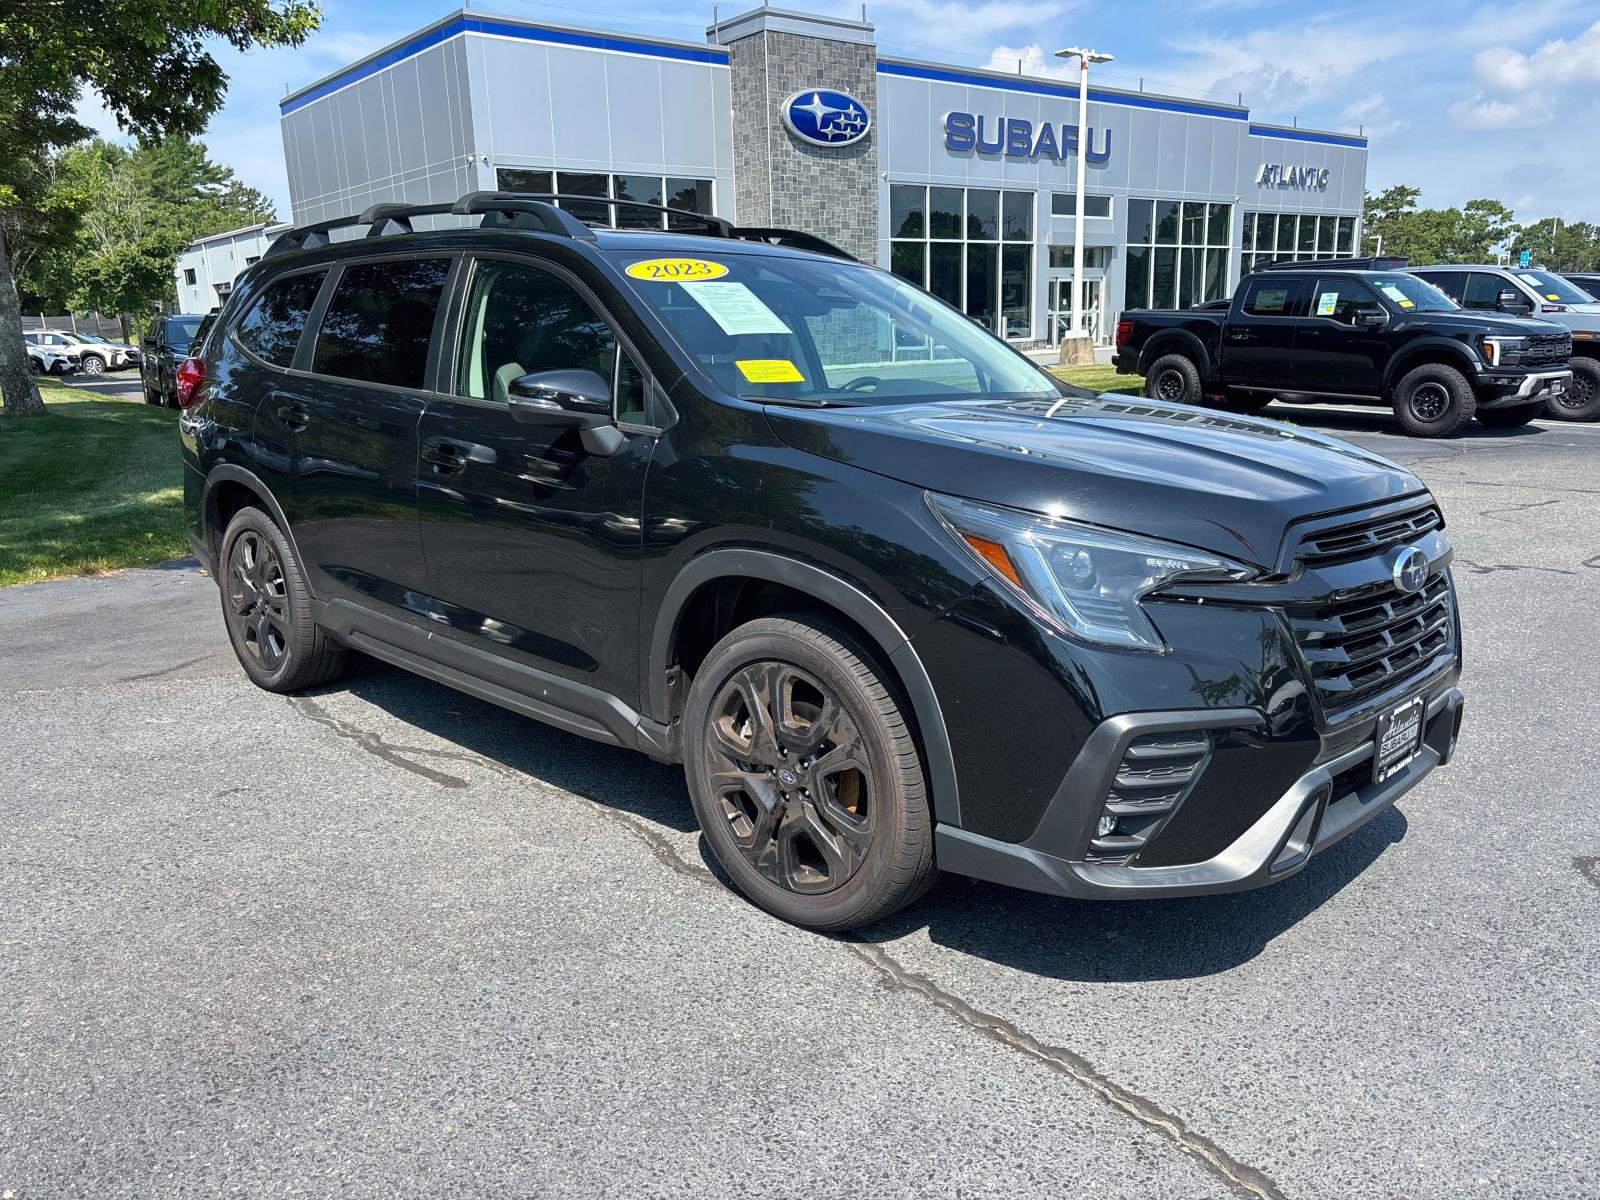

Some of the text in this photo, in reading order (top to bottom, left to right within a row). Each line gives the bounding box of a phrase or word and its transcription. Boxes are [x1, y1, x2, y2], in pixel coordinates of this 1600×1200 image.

[945, 112, 1111, 162] SUBARU
[1257, 164, 1329, 188] ATLANTIC
[646, 263, 712, 278] 2023
[1382, 710, 1420, 742] Atlantic
[1382, 732, 1409, 755] SUBARU
